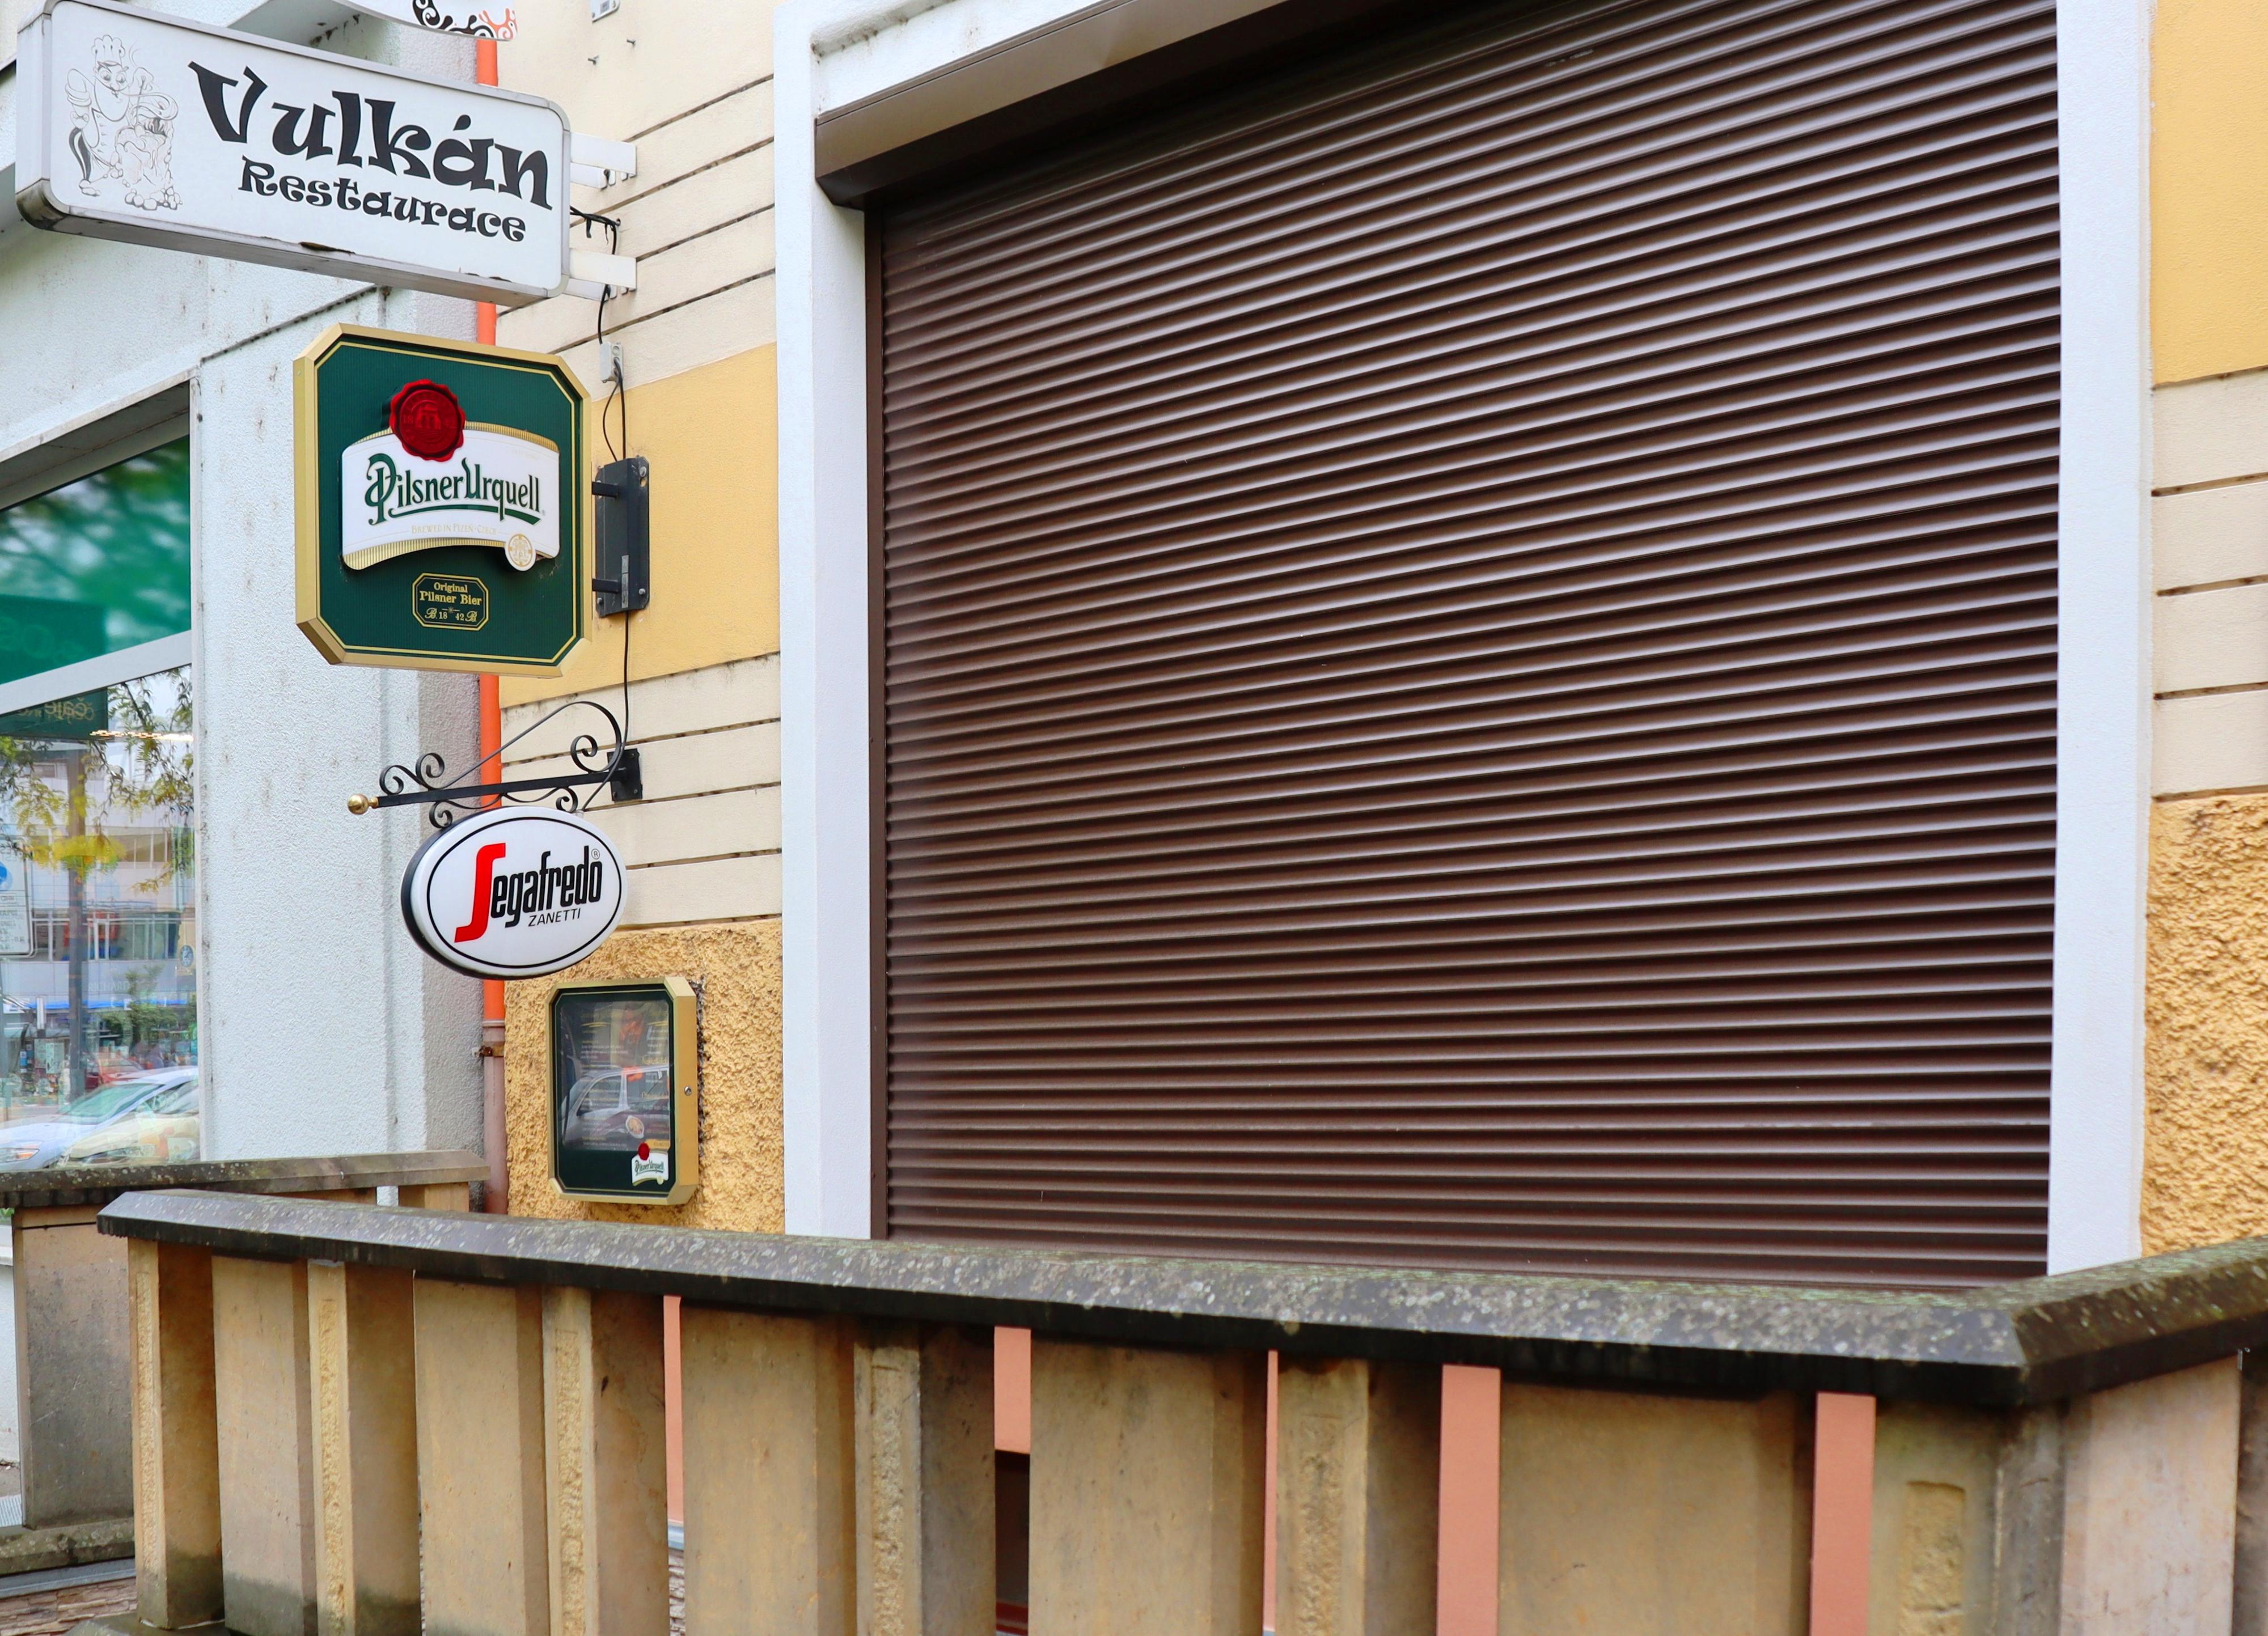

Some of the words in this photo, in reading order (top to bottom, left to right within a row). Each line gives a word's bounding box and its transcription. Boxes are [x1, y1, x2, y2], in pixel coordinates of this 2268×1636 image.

[188, 59, 553, 211] Vulkán
[238, 155, 527, 243] Restaurace
[364, 452, 464, 526] Pilsner
[462, 457, 540, 522] Urquell
[419, 591, 457, 604] Pilsner
[460, 594, 483, 605] Bier
[433, 582, 468, 594] Original
[438, 611, 448, 620] 18
[454, 842, 603, 944] Segafredo
[527, 908, 581, 927] ZANETTI
